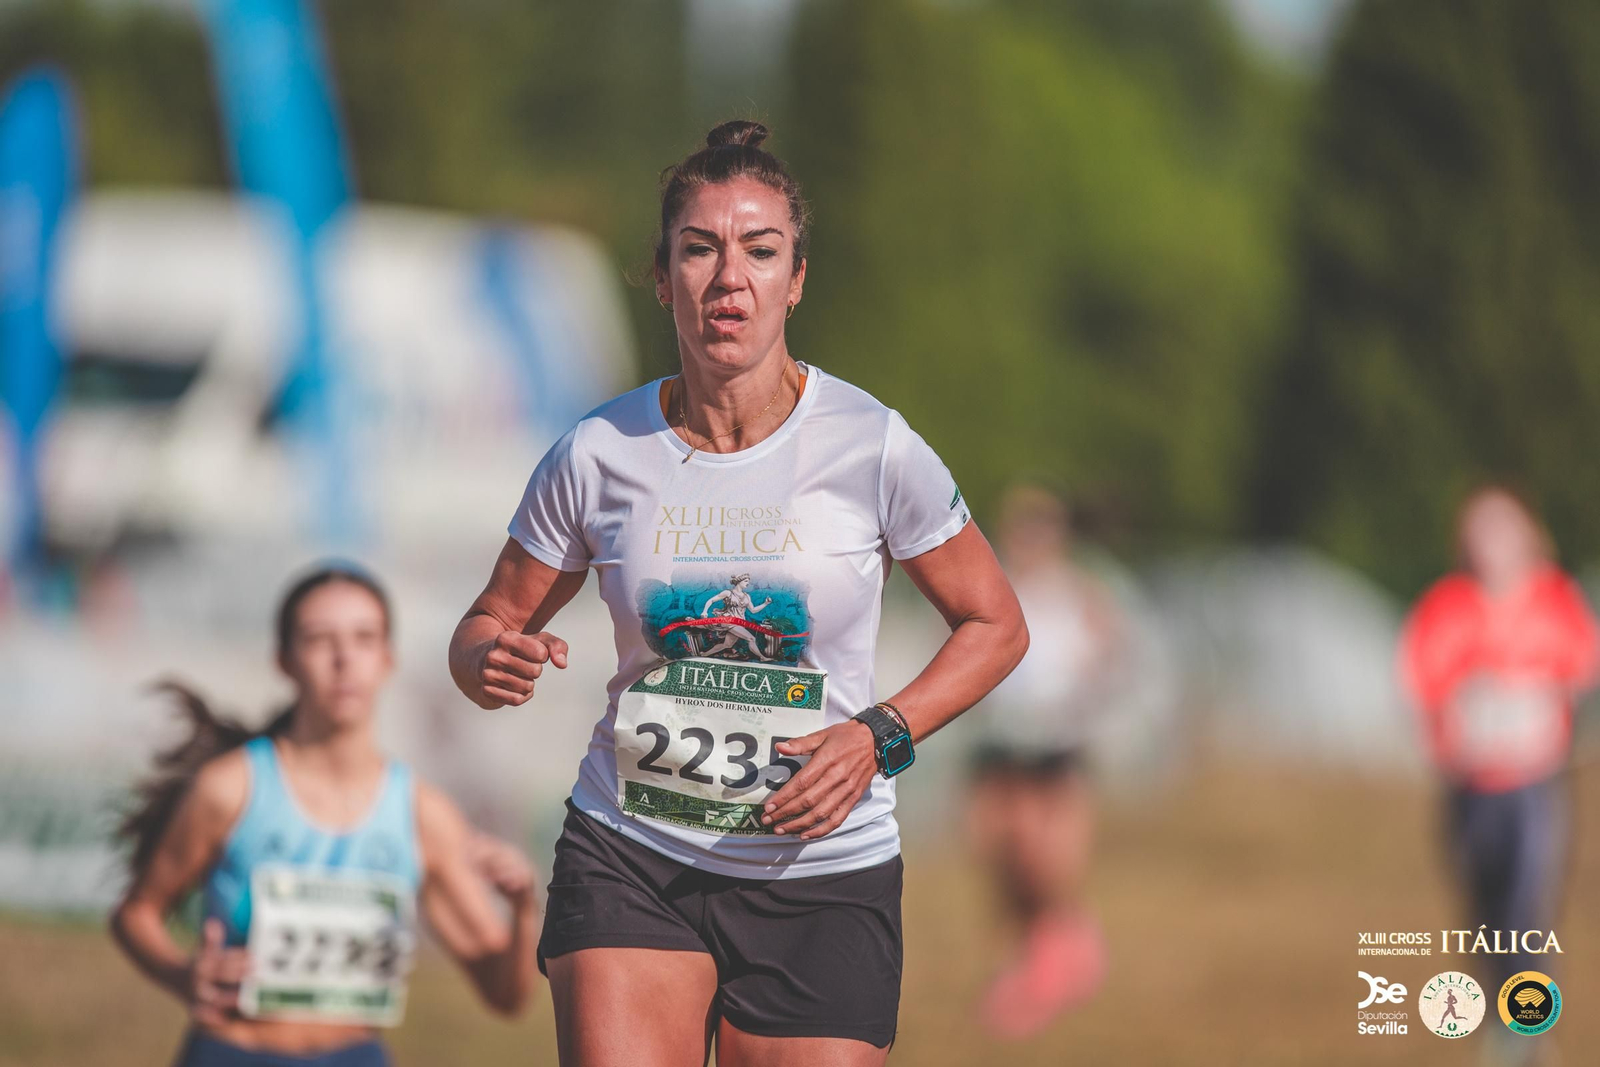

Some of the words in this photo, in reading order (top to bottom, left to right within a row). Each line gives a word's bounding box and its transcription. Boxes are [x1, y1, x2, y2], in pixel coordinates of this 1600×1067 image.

[658, 506, 726, 526] XLIII
[726, 506, 783, 520] CROSS
[726, 518, 803, 528] INTERNACIONAL
[652, 525, 806, 555] ITÁLICA
[672, 555, 729, 563] INTERNATIONAL
[752, 554, 786, 562] COUNTRY
[678, 665, 774, 694] ITÁLICA
[679, 685, 725, 694] INTERNATIONAL
[746, 691, 774, 699] COUNTRY
[675, 697, 706, 707] HYROX
[707, 701, 724, 710] DOS
[725, 703, 773, 714] HERMANAS
[636, 722, 802, 791] 2235
[690, 822, 721, 833] ANDALUZA
